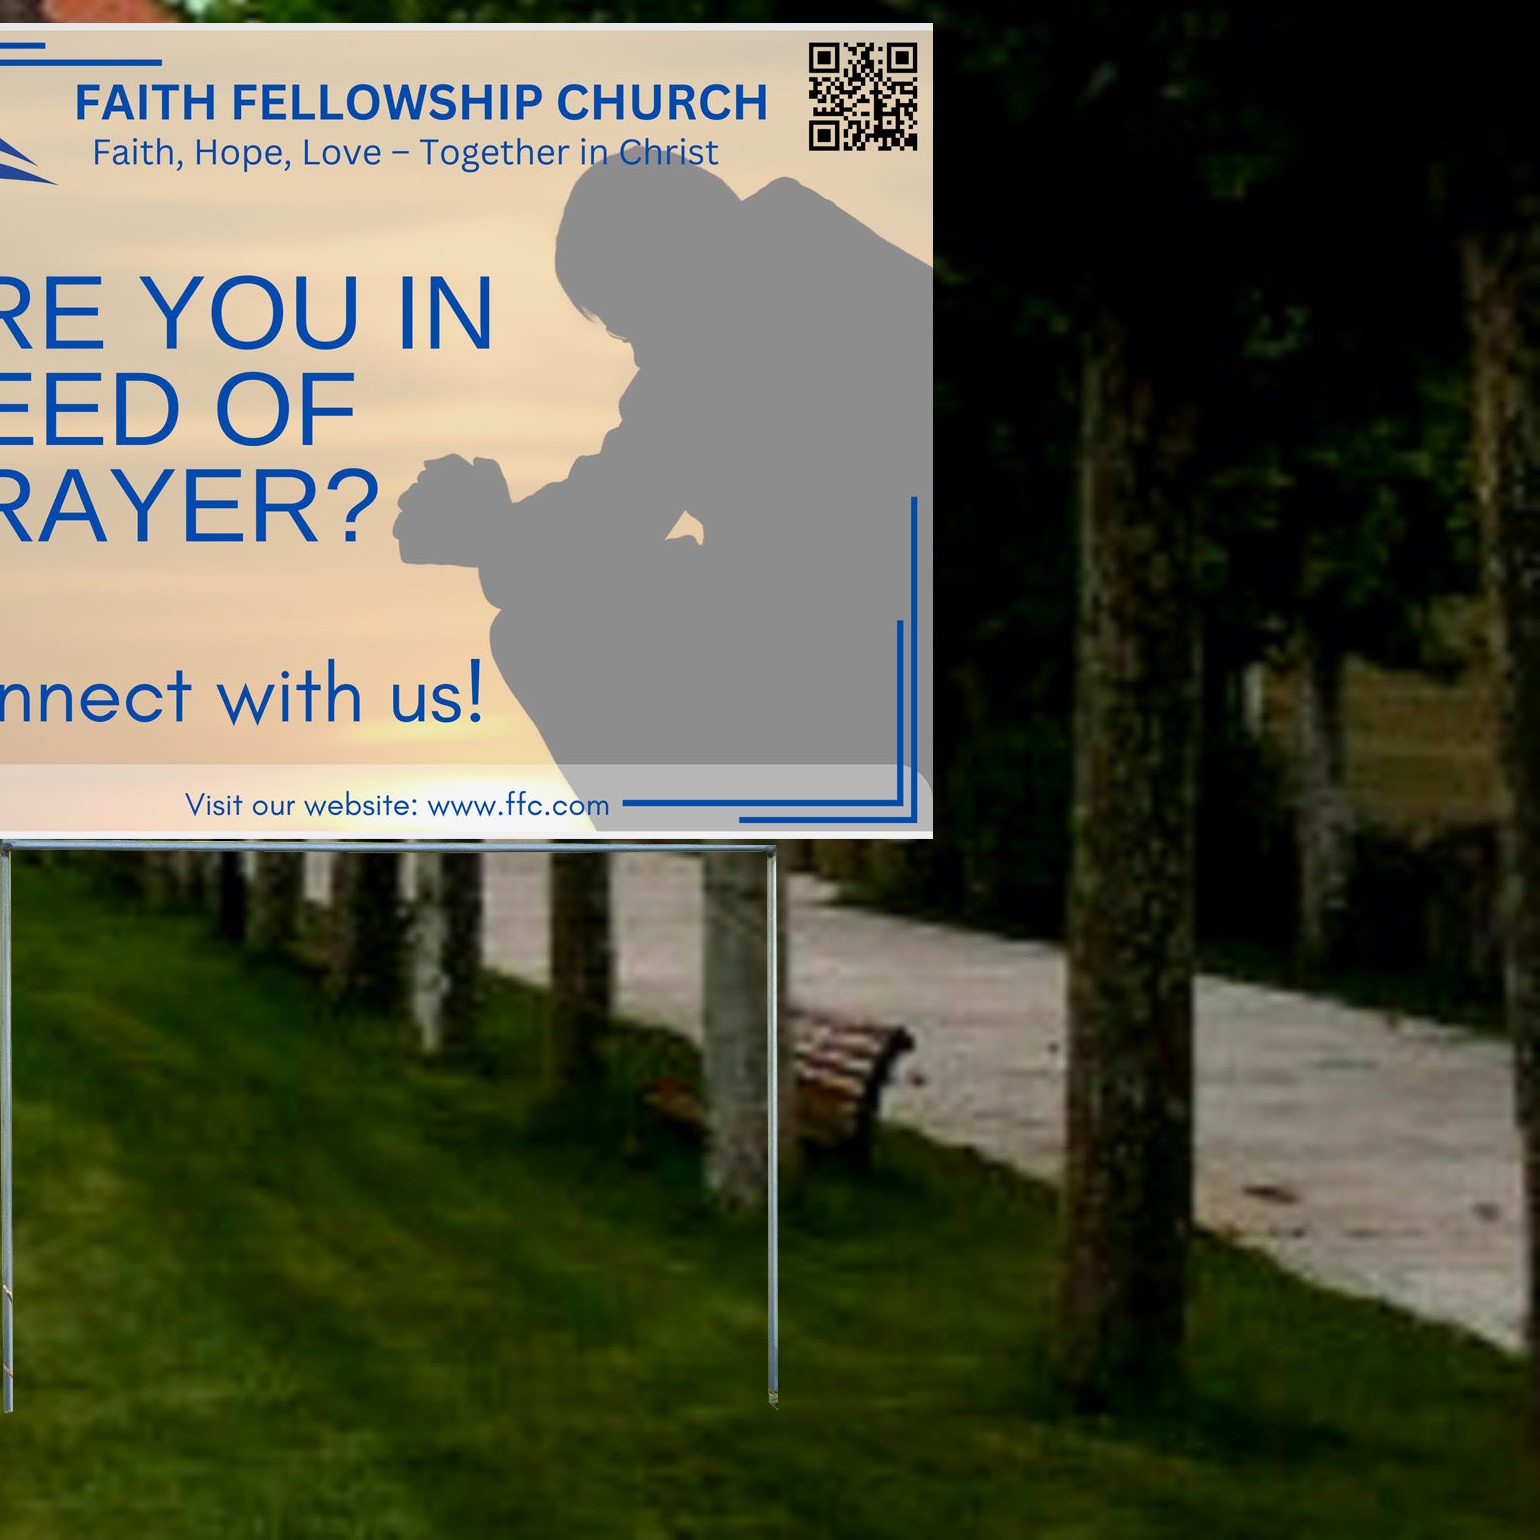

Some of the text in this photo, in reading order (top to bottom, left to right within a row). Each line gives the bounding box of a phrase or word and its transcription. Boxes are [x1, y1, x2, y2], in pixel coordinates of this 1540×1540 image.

[75, 82, 767, 122] FAITH FELLOWSHIP CHURCH
[93, 136, 184, 172] Faith,
[195, 138, 291, 173] Hope,
[303, 138, 382, 167] Love
[418, 136, 571, 174] Together
[580, 136, 610, 167] in
[618, 136, 720, 167] Christ
[139, 274, 357, 351] YOU
[401, 275, 491, 350] IN
[216, 370, 356, 447] OF
[216, 657, 361, 725] with
[392, 657, 482, 724] us!
[184, 790, 609, 817] Visit our website: www.ffc.com
